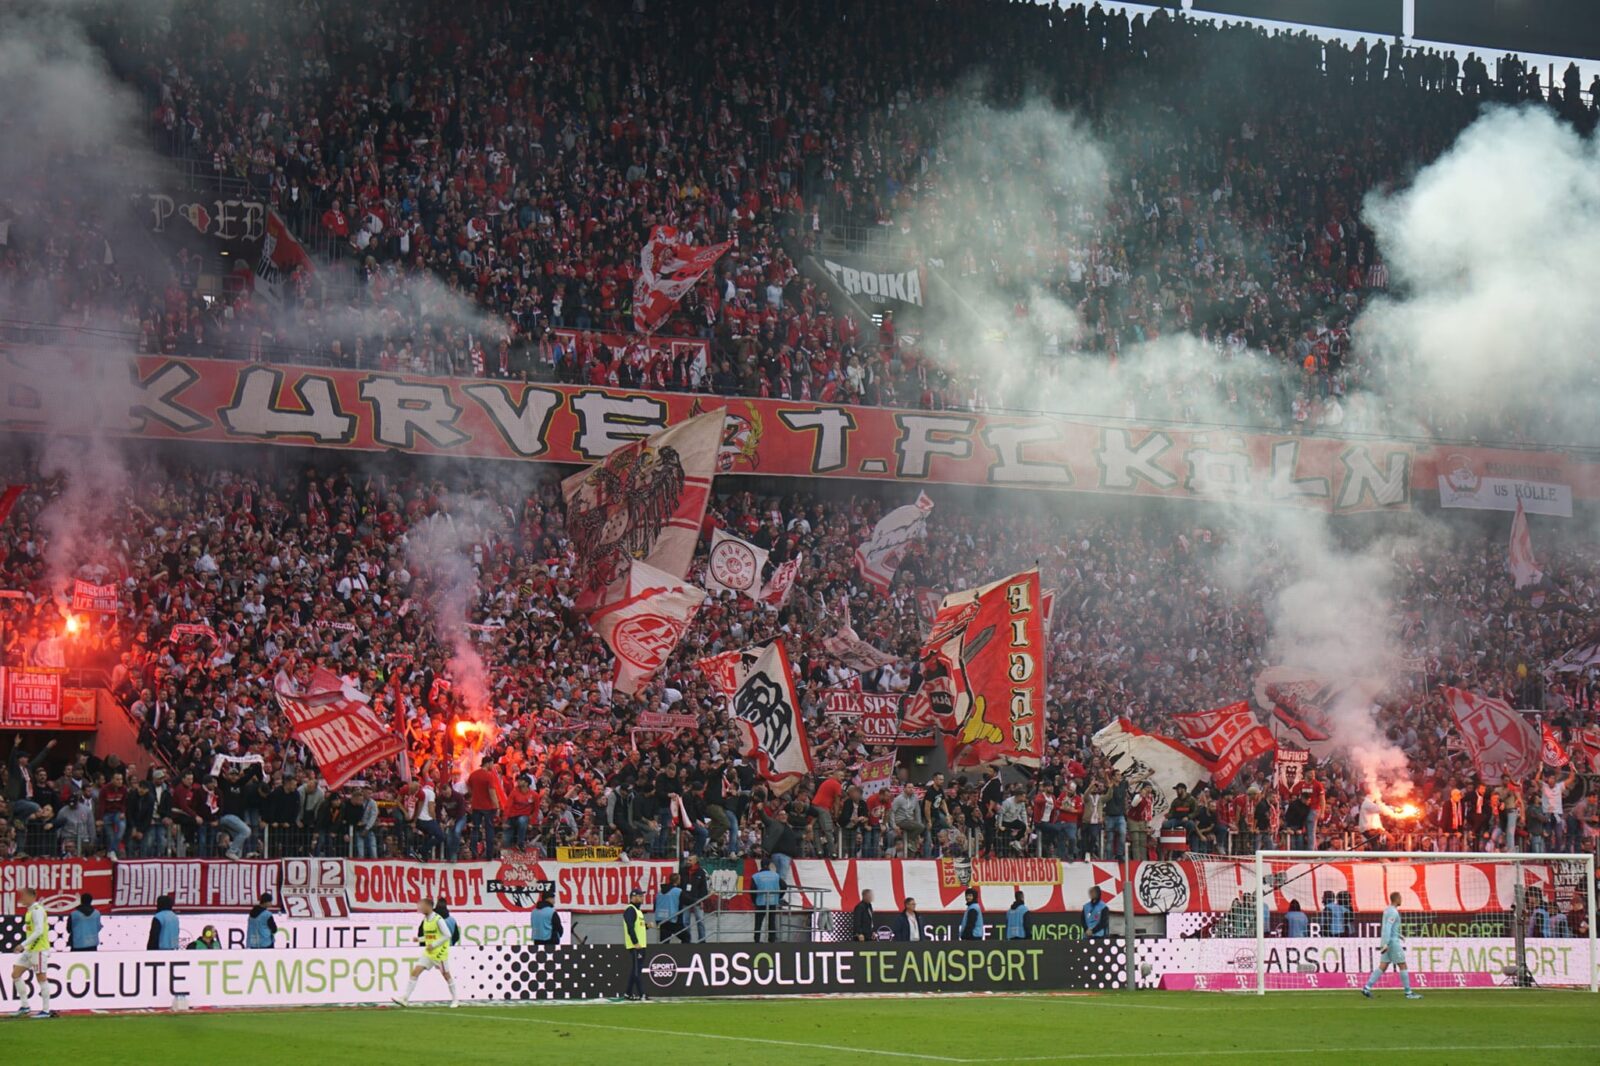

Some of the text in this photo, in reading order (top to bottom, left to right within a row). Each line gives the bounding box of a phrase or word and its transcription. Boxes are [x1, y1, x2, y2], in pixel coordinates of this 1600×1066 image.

[824, 259, 923, 307] TROIKA
[896, 413, 1075, 486] FC
[1494, 483, 1557, 501] US KÖLLE
[863, 696, 898, 713] SPS
[864, 718, 897, 735] CGN
[1228, 727, 1275, 766] VFL
[1277, 750, 1309, 761] RAFIKIS
[0, 863, 82, 892] SDORFER
[115, 863, 278, 907] SEMPER FIDELIS
[944, 860, 956, 885] SEK
[971, 858, 1059, 883] STADIONVERBOT
[354, 865, 484, 906] DOMSTADT
[651, 962, 676, 971] SPORT
[653, 970, 674, 978] 2000
[685, 949, 1044, 987] ABSOLUTE TEAMSPORT
[1411, 946, 1572, 977] TEAMSPORT
[0, 961, 190, 1000] BSOLUTE
